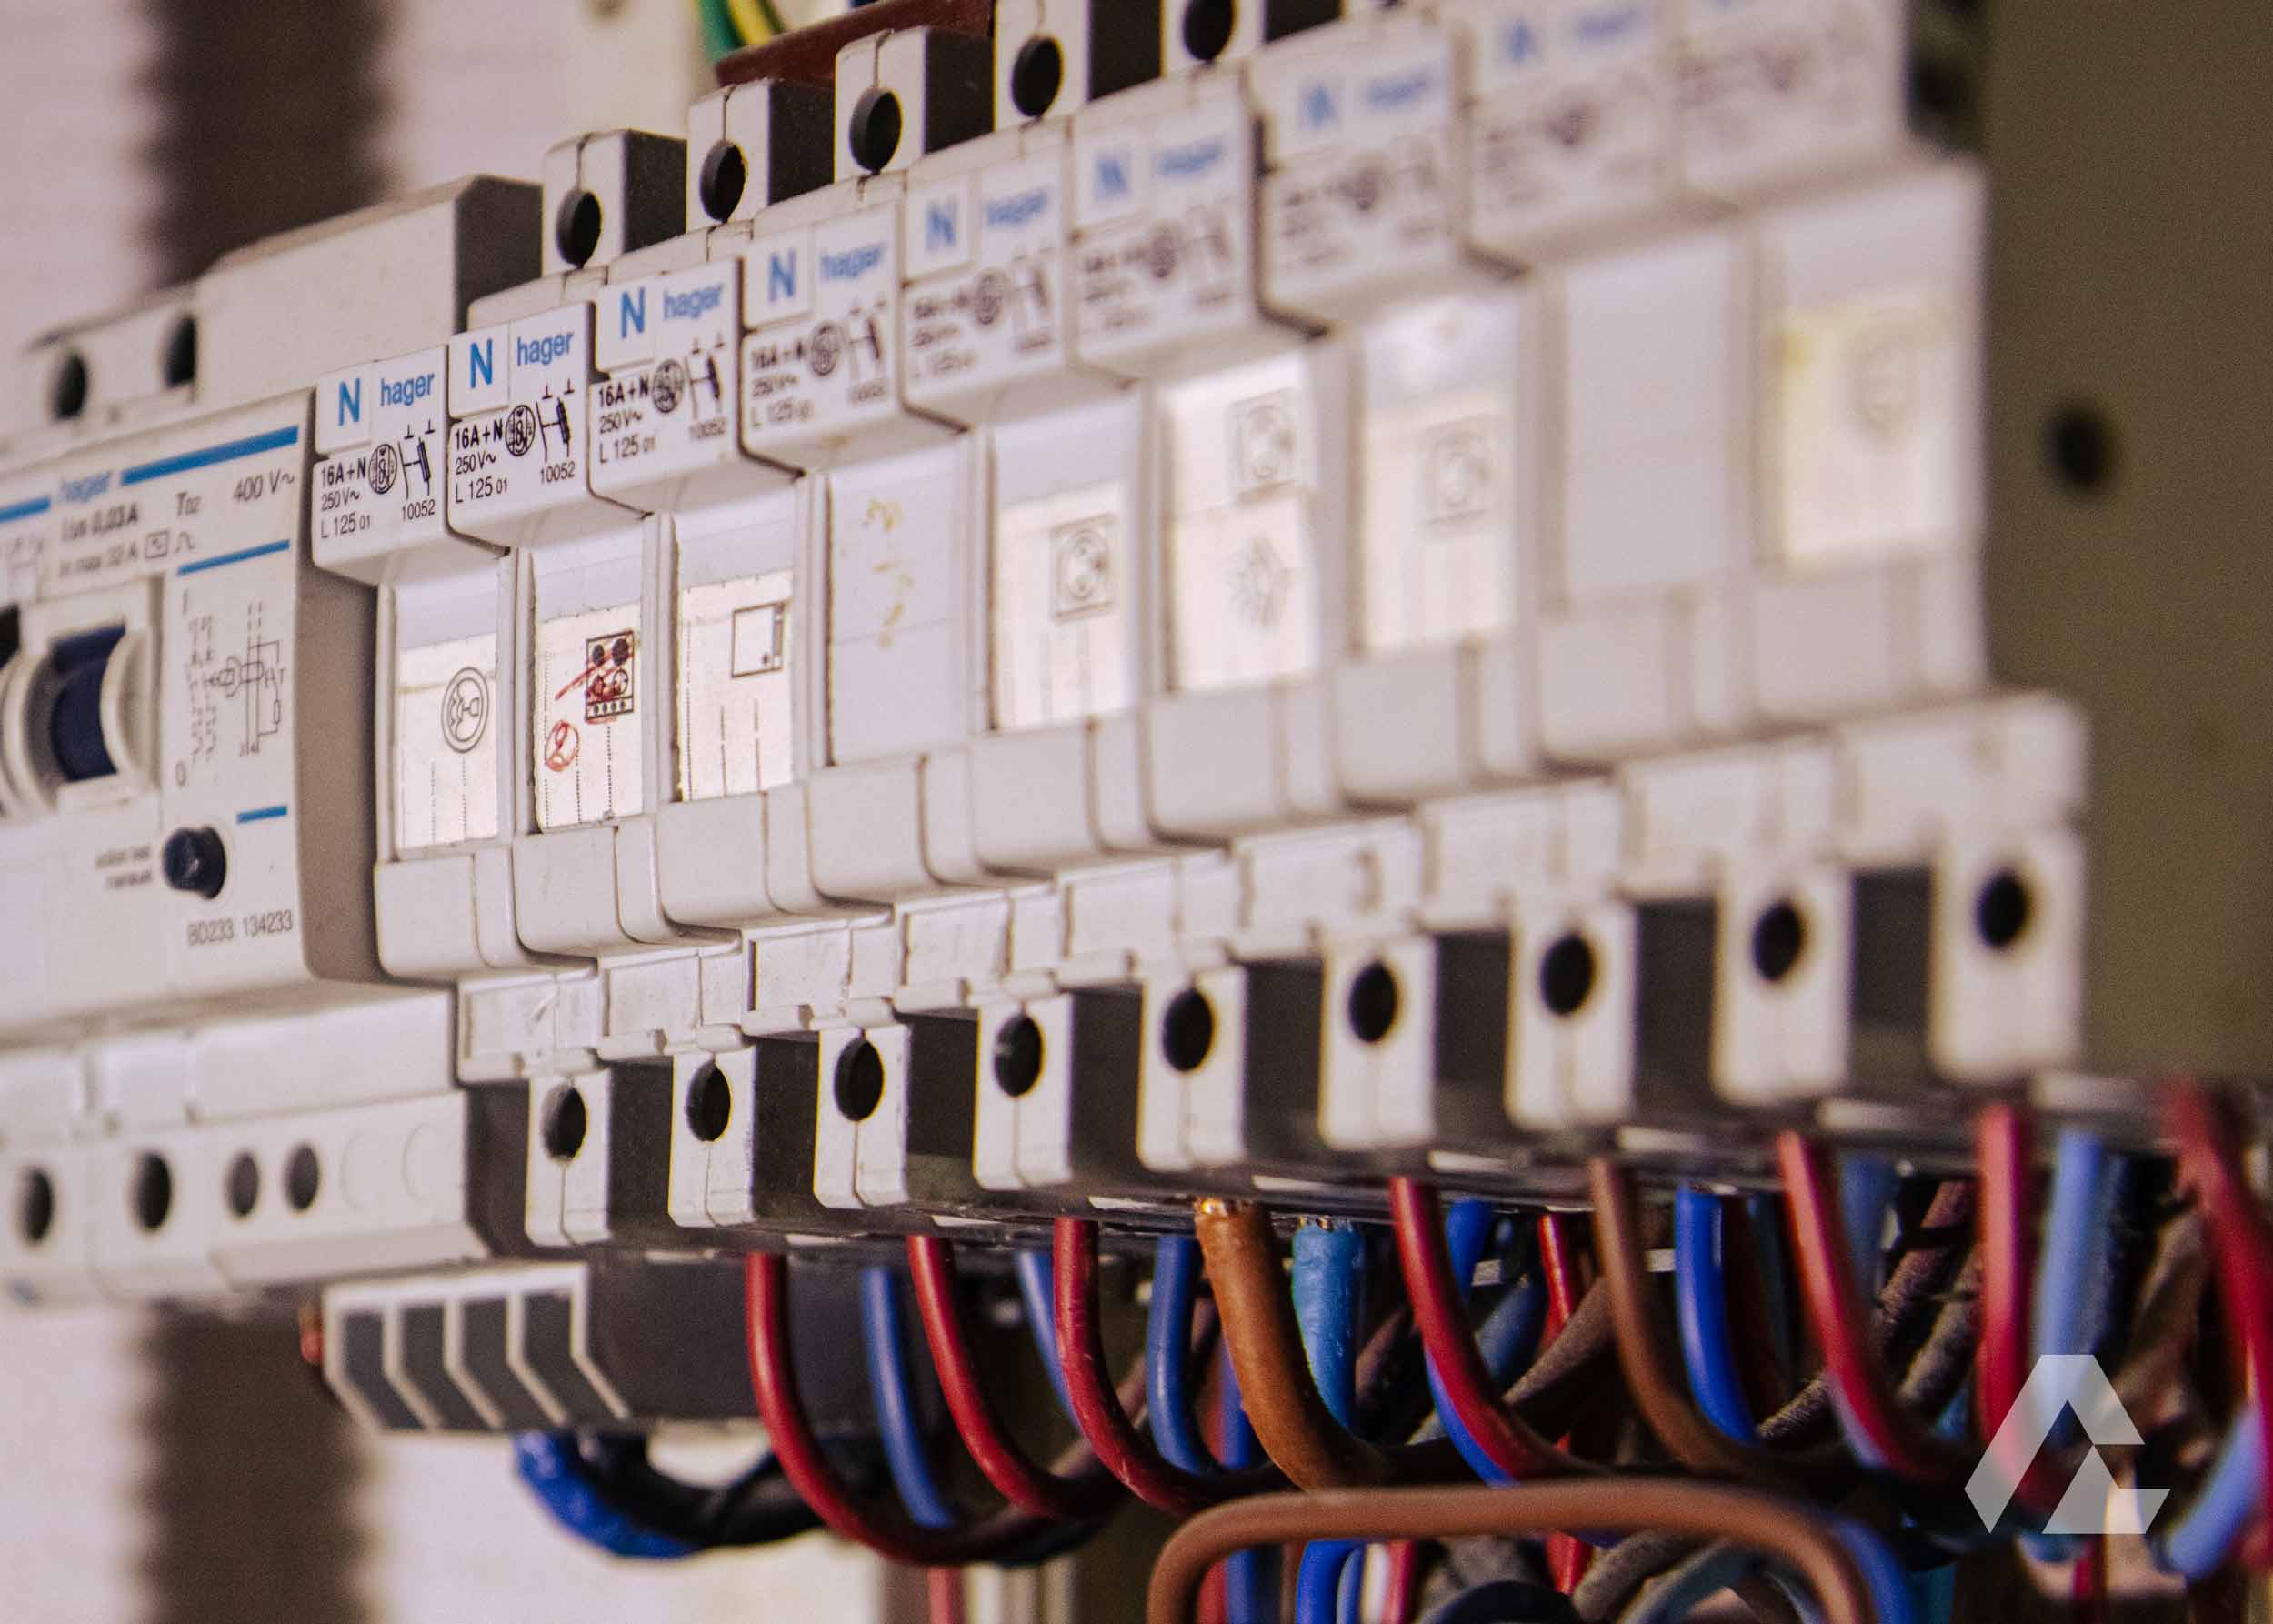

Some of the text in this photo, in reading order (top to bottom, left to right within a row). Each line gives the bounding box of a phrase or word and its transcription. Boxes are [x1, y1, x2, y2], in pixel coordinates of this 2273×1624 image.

[768, 249, 796, 304] N
[621, 283, 723, 341] N hager
[469, 331, 575, 389] N hager
[338, 373, 436, 427] N hager
[234, 476, 264, 502] 400
[540, 461, 576, 485] 10052
[401, 499, 436, 523] 10052
[243, 909, 293, 938] 134233
